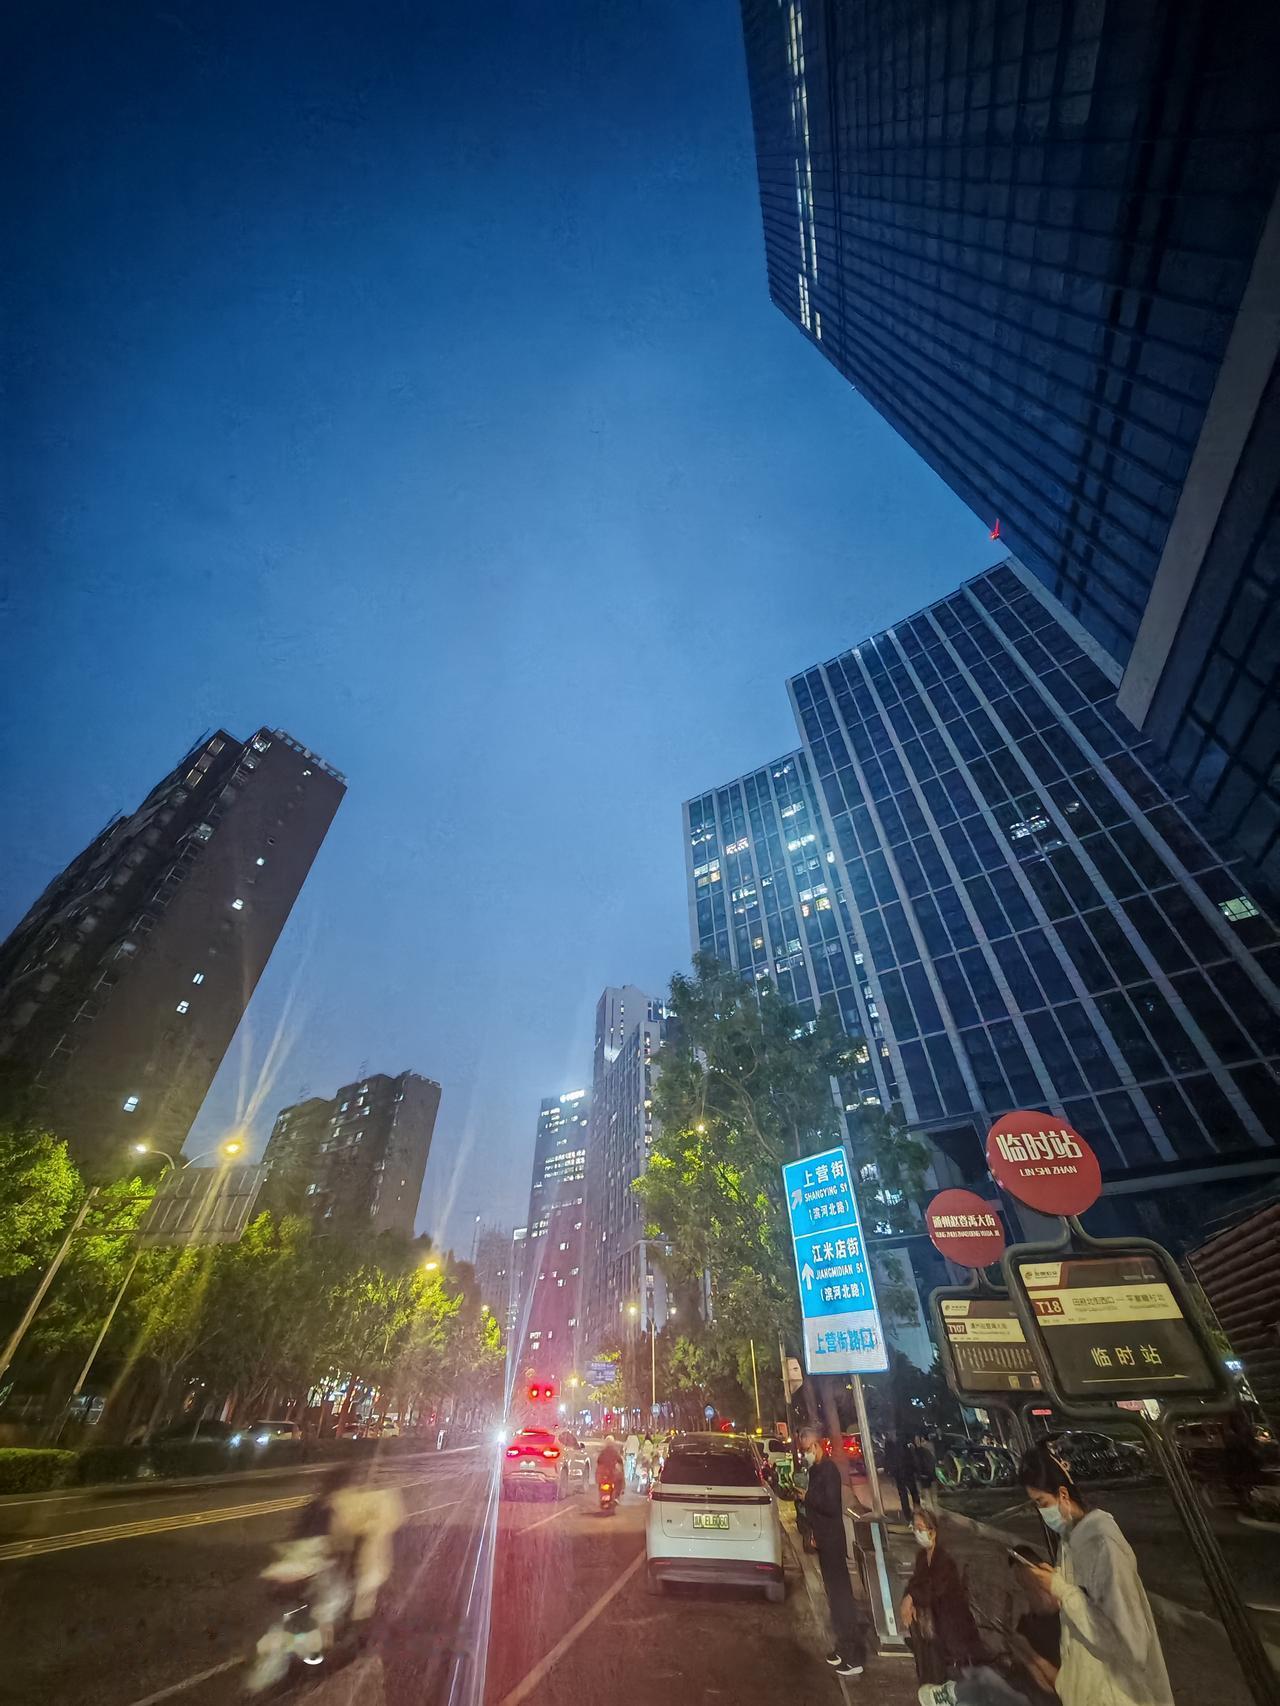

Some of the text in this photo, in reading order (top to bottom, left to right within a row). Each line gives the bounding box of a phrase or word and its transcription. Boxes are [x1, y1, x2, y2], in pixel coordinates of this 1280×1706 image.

[996, 1130, 1083, 1162] 临时站
[803, 1160, 844, 1188] 上营街
[1020, 1165, 1078, 1177] LIN SHI ZHAN
[804, 1185, 838, 1202] SHANGYING
[811, 1237, 859, 1263] 江米店街
[815, 1264, 853, 1280] JIANGMIDIAN
[1035, 1300, 1062, 1314] T18
[815, 1327, 875, 1354] 上营街路口
[1091, 1344, 1162, 1367] 临时站
